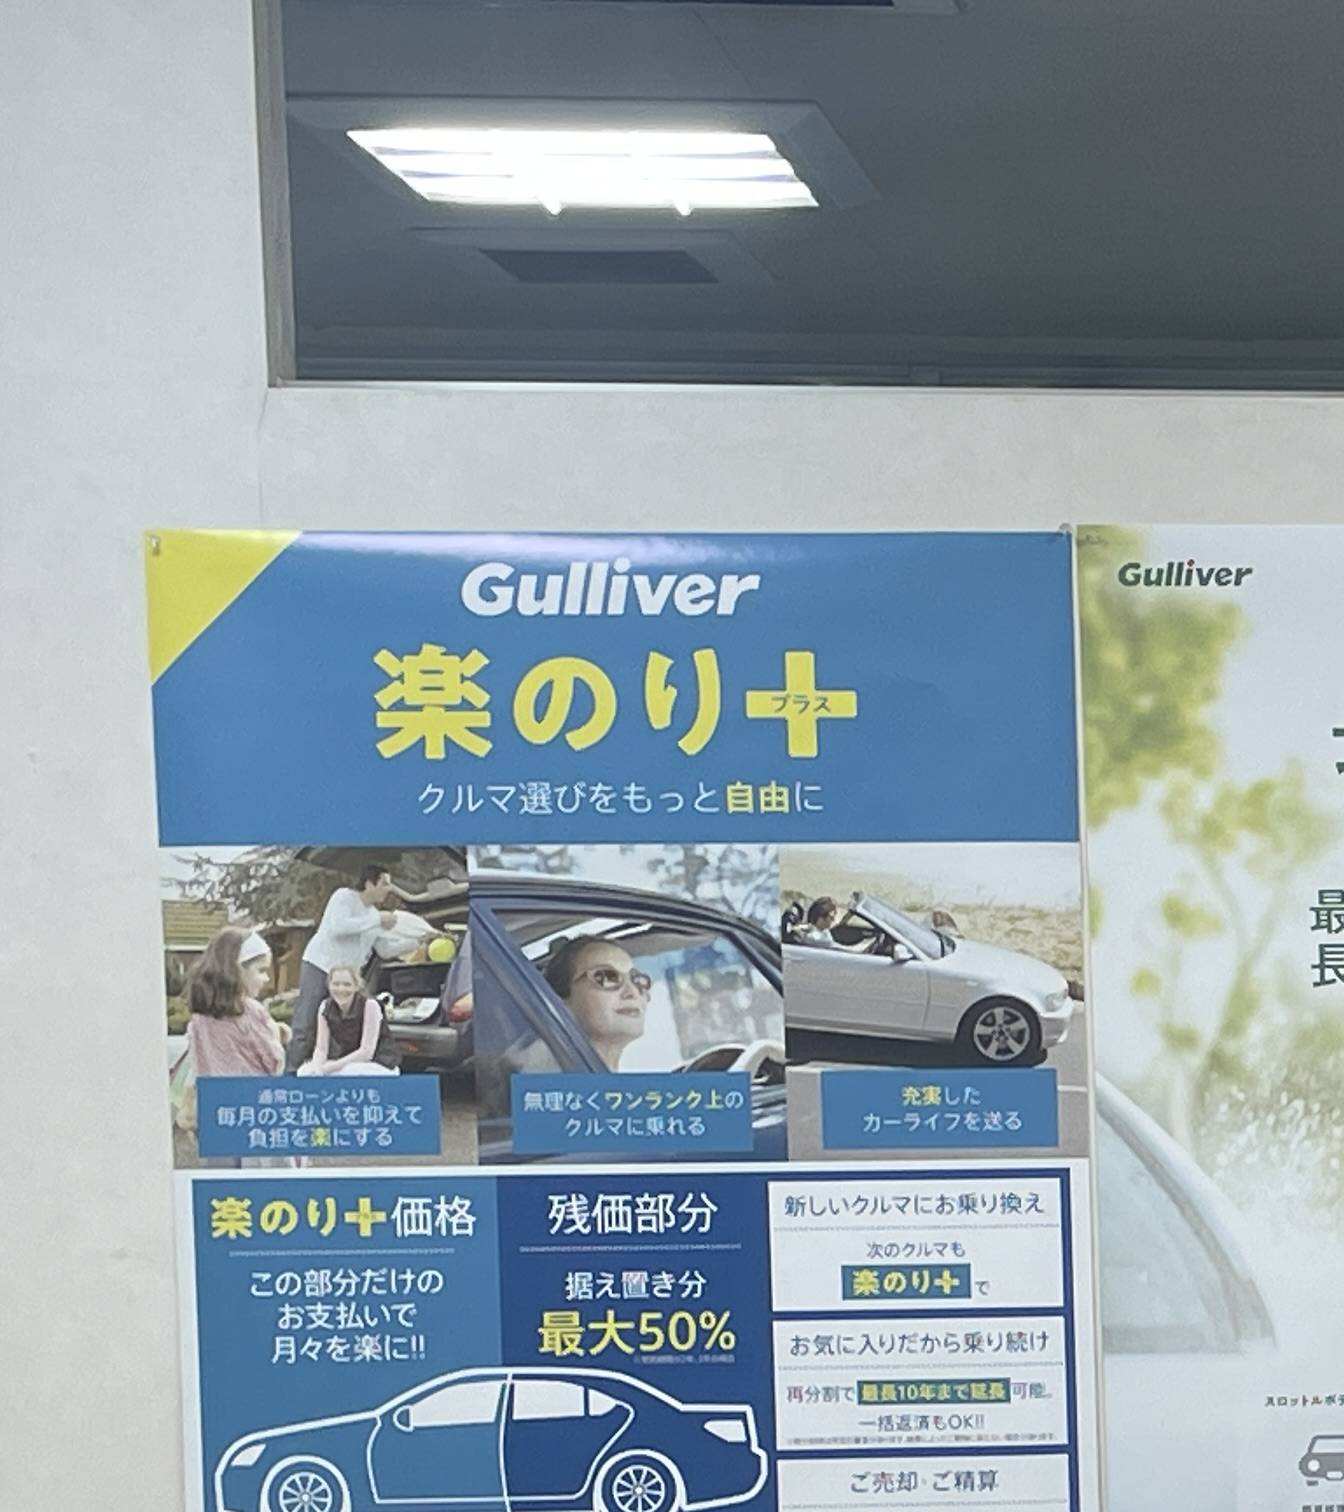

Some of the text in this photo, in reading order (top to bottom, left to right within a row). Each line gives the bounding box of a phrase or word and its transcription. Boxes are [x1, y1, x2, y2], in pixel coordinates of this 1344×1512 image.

[1117, 559, 1254, 589] Gulliver
[461, 557, 761, 618] Gulliver
[771, 693, 832, 715] プラス
[416, 780, 824, 816] クルマ選びをもっと自由に
[257, 1088, 381, 1105] 通常ローンよりも
[523, 1088, 745, 1113] 無理なくワンランク上の
[902, 1085, 982, 1106] 充実した
[217, 1105, 423, 1128] 毎月の支払いを抑えて
[565, 1116, 706, 1138] クルマに乗れる
[863, 1110, 1023, 1132] カーライフを送る
[248, 1127, 393, 1149] 負担を楽にする
[548, 1193, 719, 1236] 残価部分
[784, 1191, 1045, 1217] 新しいクルマにお乗り換え
[866, 1241, 966, 1259] 次のクルマも
[250, 1267, 444, 1298] この部分だけの
[564, 1270, 707, 1302] 据え置き分
[277, 1301, 416, 1331] お支払いで
[538, 1310, 737, 1357] 最大50%
[789, 1330, 1049, 1357] お気に入りだから乗り続け
